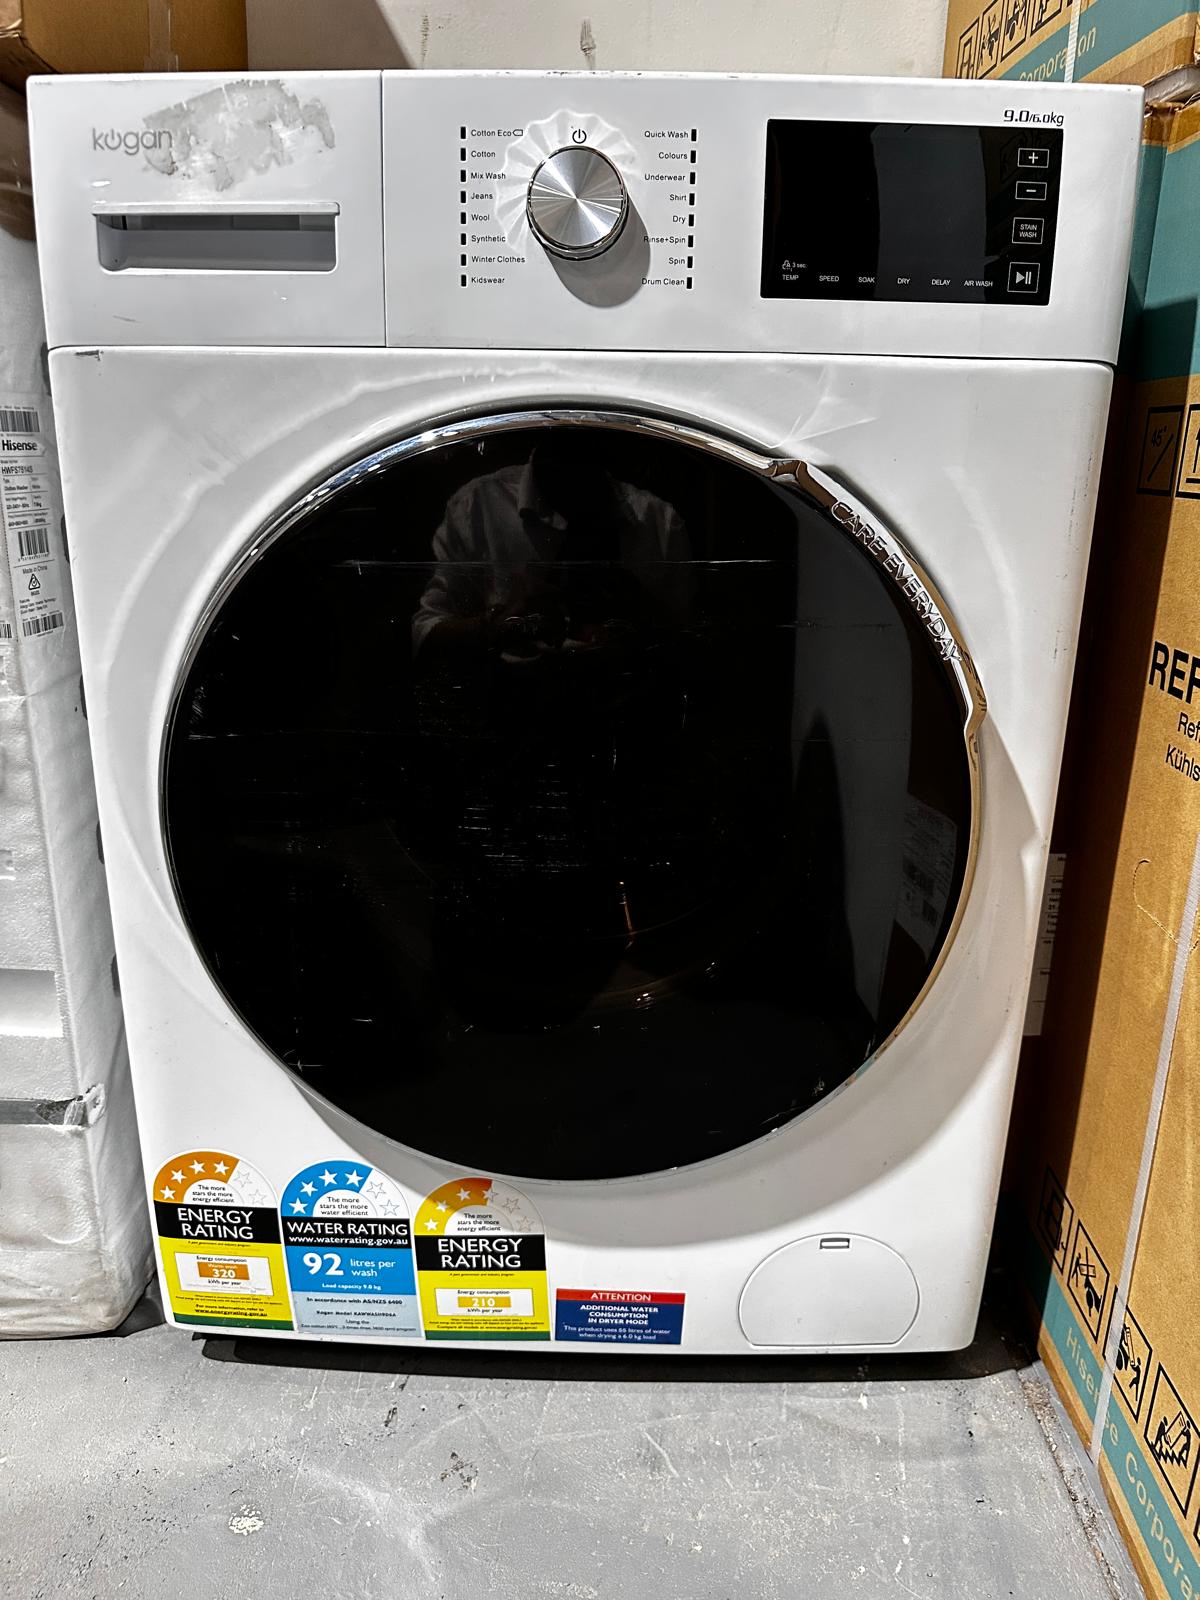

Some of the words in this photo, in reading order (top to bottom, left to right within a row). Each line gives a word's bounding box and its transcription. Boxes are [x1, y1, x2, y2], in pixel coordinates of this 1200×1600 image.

[470, 129, 496, 137] Cotton
[497, 129, 512, 137] Eco
[644, 130, 666, 139] Quick
[667, 130, 689, 138] Wash
[92, 127, 173, 156] kogan
[470, 150, 496, 158] Cotton
[658, 152, 688, 160] Colours
[470, 172, 483, 180] Mix
[484, 172, 506, 180] Wash
[644, 173, 686, 182] Underwear
[470, 192, 493, 200] Jeans
[669, 193, 687, 202] Shirt
[471, 213, 490, 221] Wool
[672, 215, 686, 224] Dry
[1019, 223, 1038, 231] STAIN
[471, 235, 506, 243] Synthetic
[1018, 231, 1038, 239] WASH
[643, 235, 686, 245] Rinse+Spin
[471, 255, 495, 263] Winter
[496, 255, 526, 263] Clothes
[668, 257, 685, 266] Spin
[471, 276, 506, 284] Kidswear
[641, 277, 662, 286] Drum
[663, 278, 685, 286] Clean
[781, 273, 800, 281] TEMP
[818, 275, 840, 283] SPEED
[858, 276, 875, 284] SOAK
[897, 277, 911, 286] DRY
[931, 278, 951, 286] DELAY
[963, 279, 975, 287] AIR
[975, 280, 994, 288] WASH
[1, 439, 38, 451] Hisense
[830, 500, 889, 556] CARE
[882, 552, 963, 662] EVERYDAY
[1177, 711, 1200, 743] Ref
[177, 1207, 254, 1225] ENERGY
[181, 1223, 254, 1240] RATING
[286, 1221, 344, 1235] WATER
[347, 1223, 408, 1236] RATING
[288, 1235, 409, 1247] www.waterrating.gov.au
[437, 1238, 523, 1253] ENERGY
[303, 1252, 345, 1277] 92
[350, 1258, 376, 1268] litres
[378, 1260, 396, 1270] per
[441, 1254, 522, 1268] RATING
[212, 1269, 236, 1279] 320
[351, 1269, 378, 1278] wash
[337, 1283, 363, 1291] capacity
[590, 1292, 652, 1302] ATTENTION
[471, 1297, 496, 1307] 210
[579, 1304, 630, 1312] ADDITIONAL
[589, 1311, 649, 1319] CONSUMPTION
[1124, 1451, 1200, 1600] Corpora
